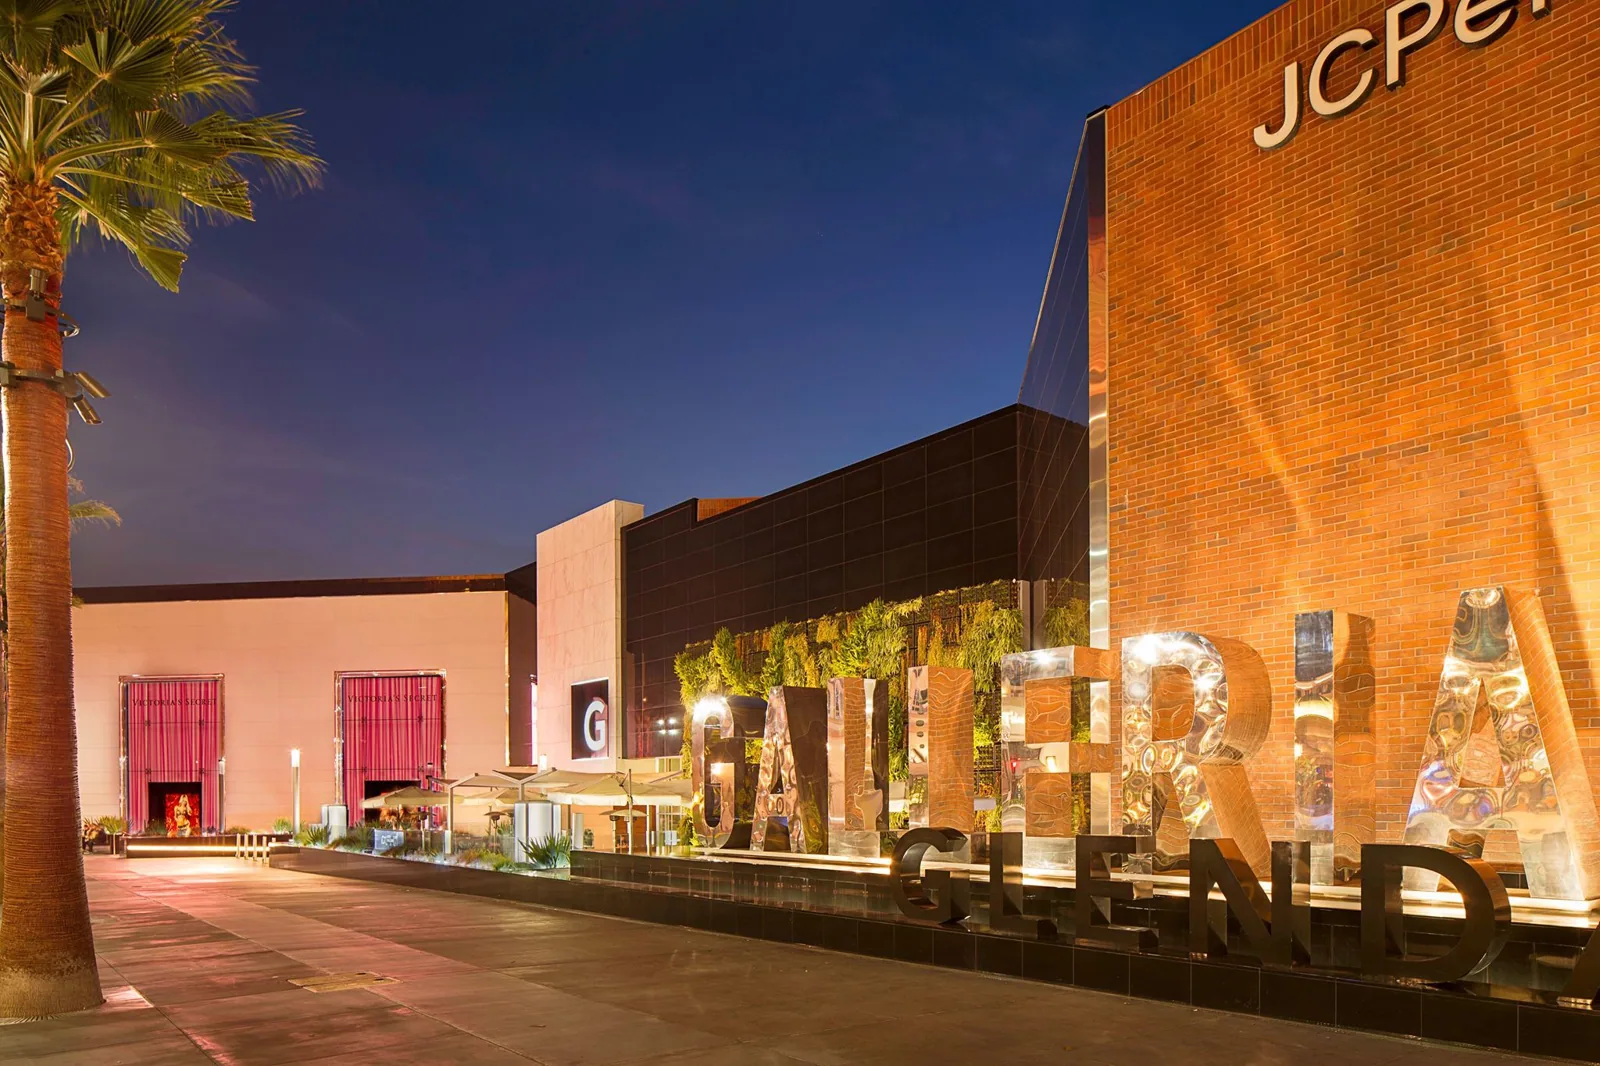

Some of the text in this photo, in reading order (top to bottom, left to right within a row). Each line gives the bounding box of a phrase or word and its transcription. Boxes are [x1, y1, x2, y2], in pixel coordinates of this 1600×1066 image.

[1253, 0, 1550, 149] JCPe
[132, 698, 217, 707] VICTORIA'S SECRET
[347, 694, 437, 703] VICTORIA'S SECRET
[583, 700, 606, 751] G
[692, 586, 1597, 901] GALLERIA
[894, 827, 1600, 1004] GLEND
